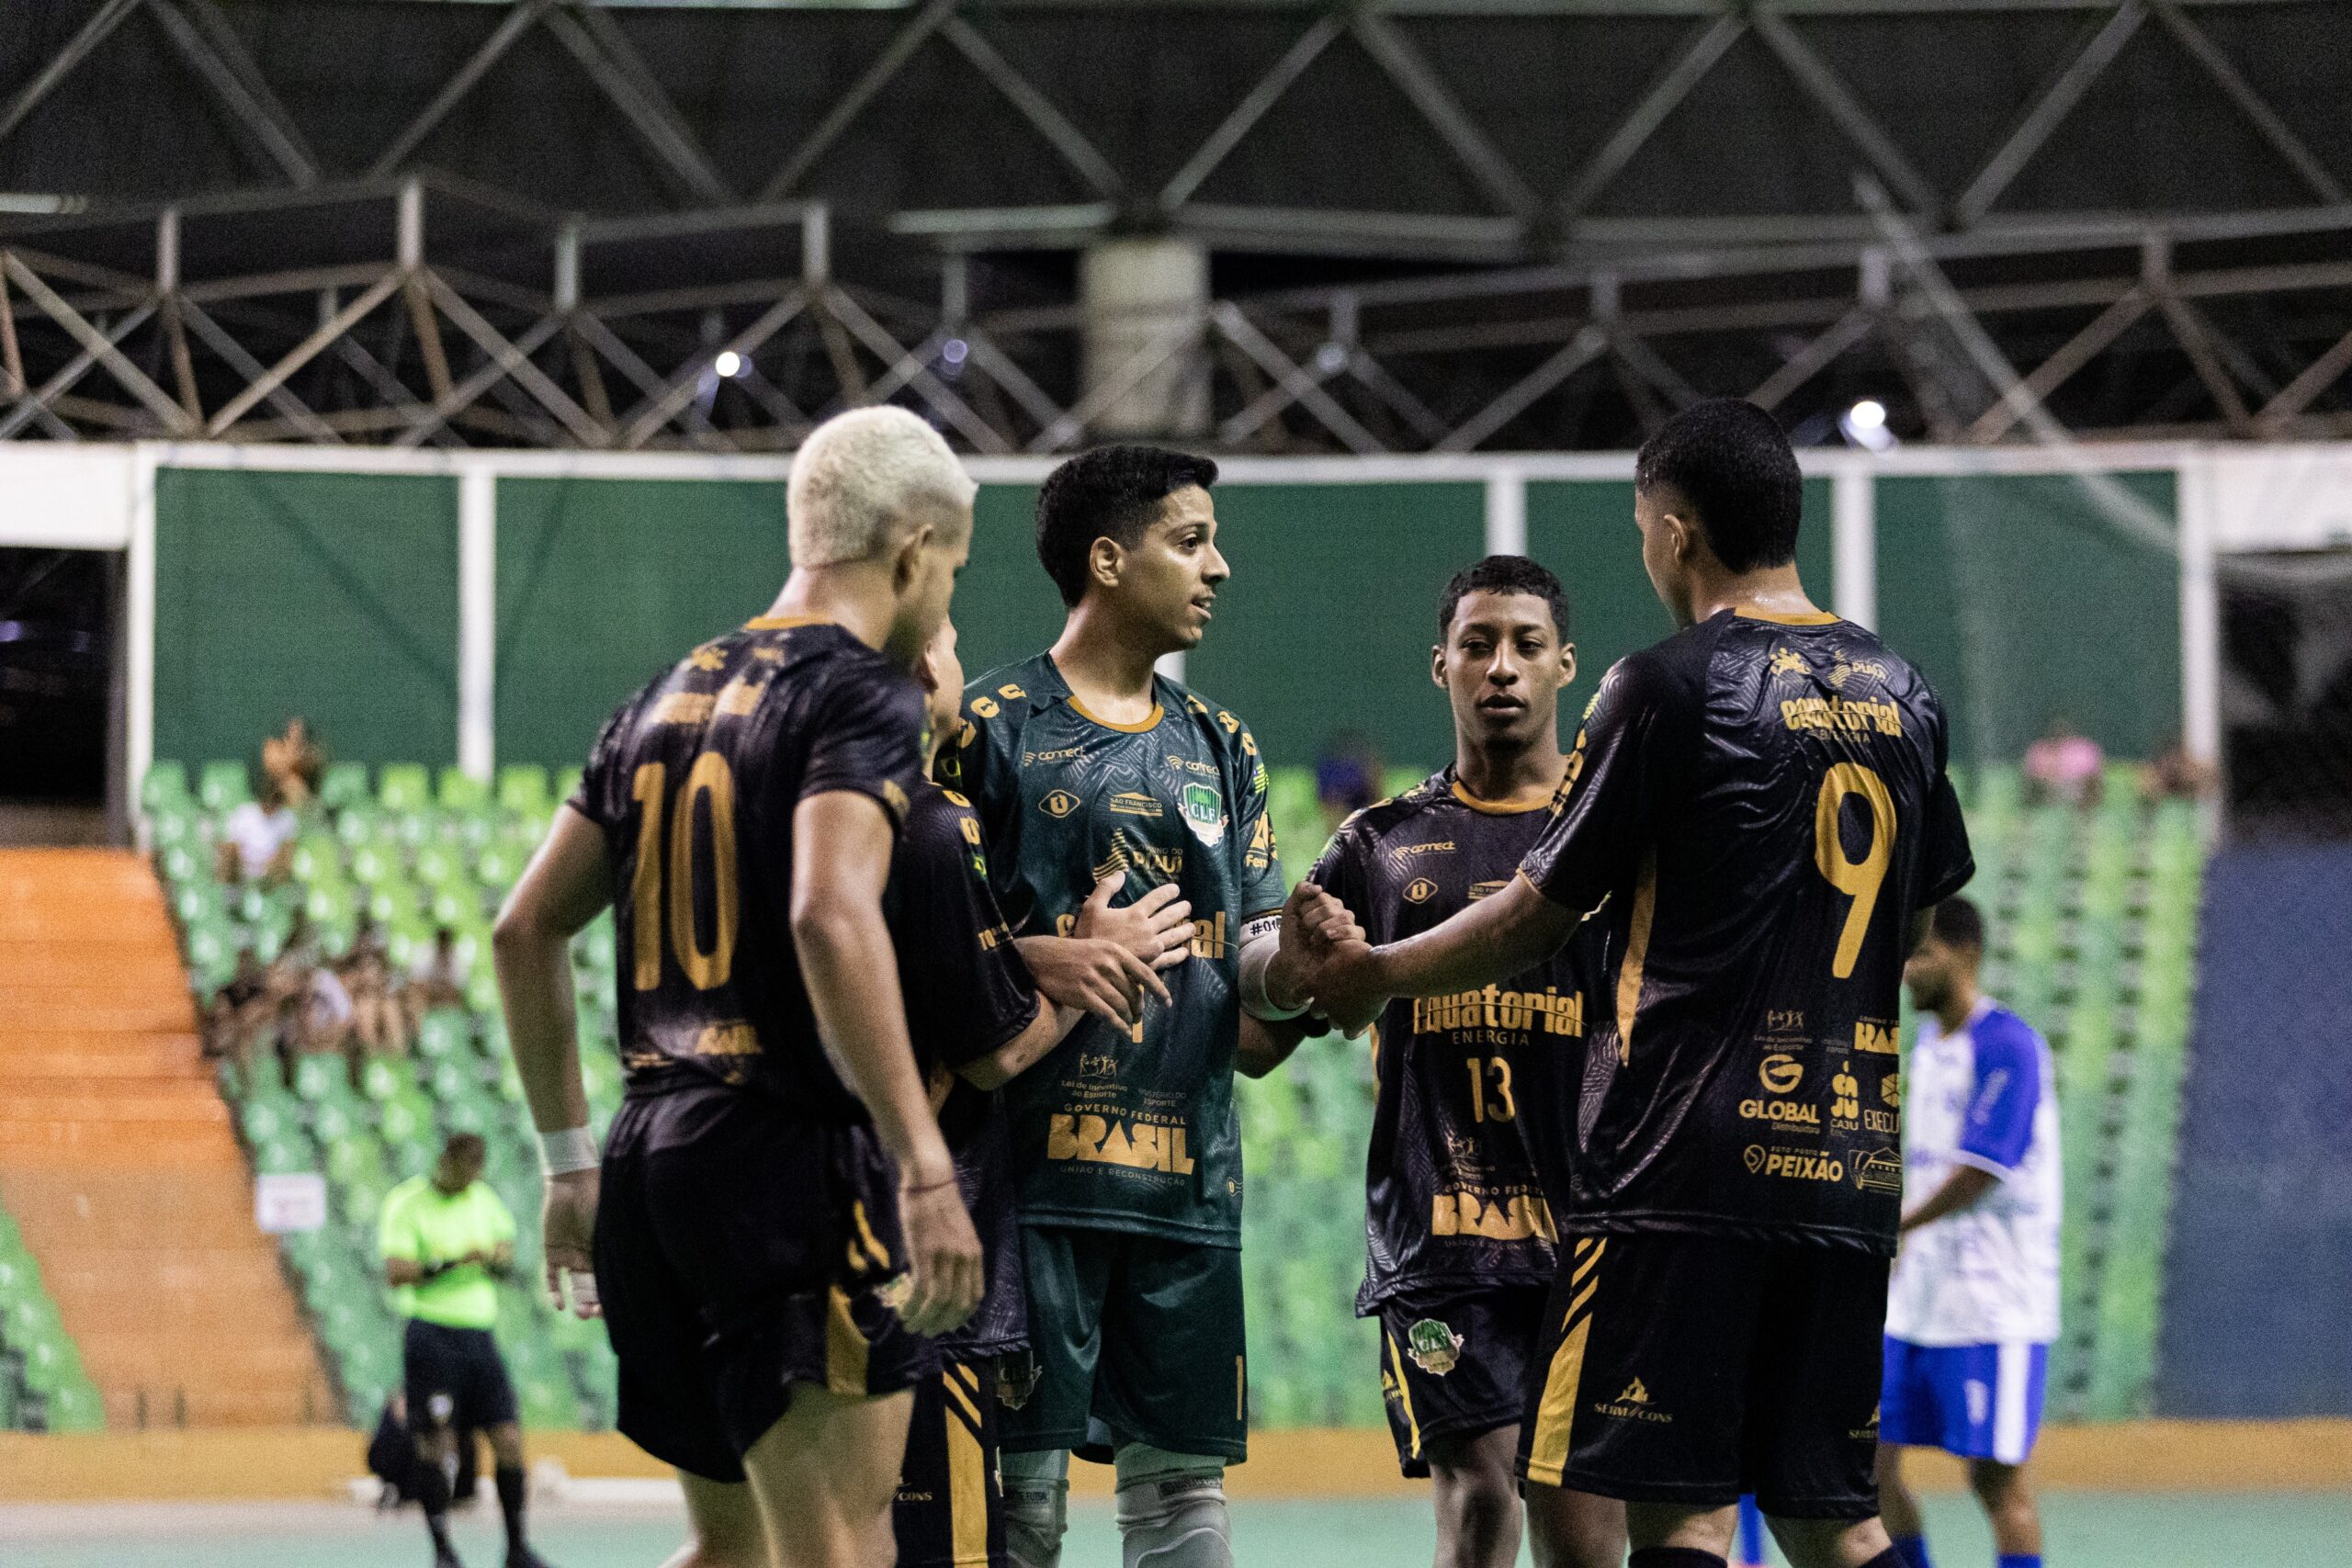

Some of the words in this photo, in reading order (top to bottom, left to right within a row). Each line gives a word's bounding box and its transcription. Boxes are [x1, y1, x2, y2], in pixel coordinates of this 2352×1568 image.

[1191, 804, 1216, 821] CLF
[634, 750, 736, 992] 10
[1815, 761, 1897, 979] 9
[1452, 1029, 1530, 1046] ENERGIA
[1466, 1056, 1516, 1123] 13
[1064, 1103, 1127, 1117] GOVERNO
[1130, 1111, 1187, 1125] FEDERAL
[1738, 1099, 1821, 1124] GLOBAL
[1047, 1113, 1194, 1176] BRASIL
[1765, 1150, 1844, 1182] PEIXÃO
